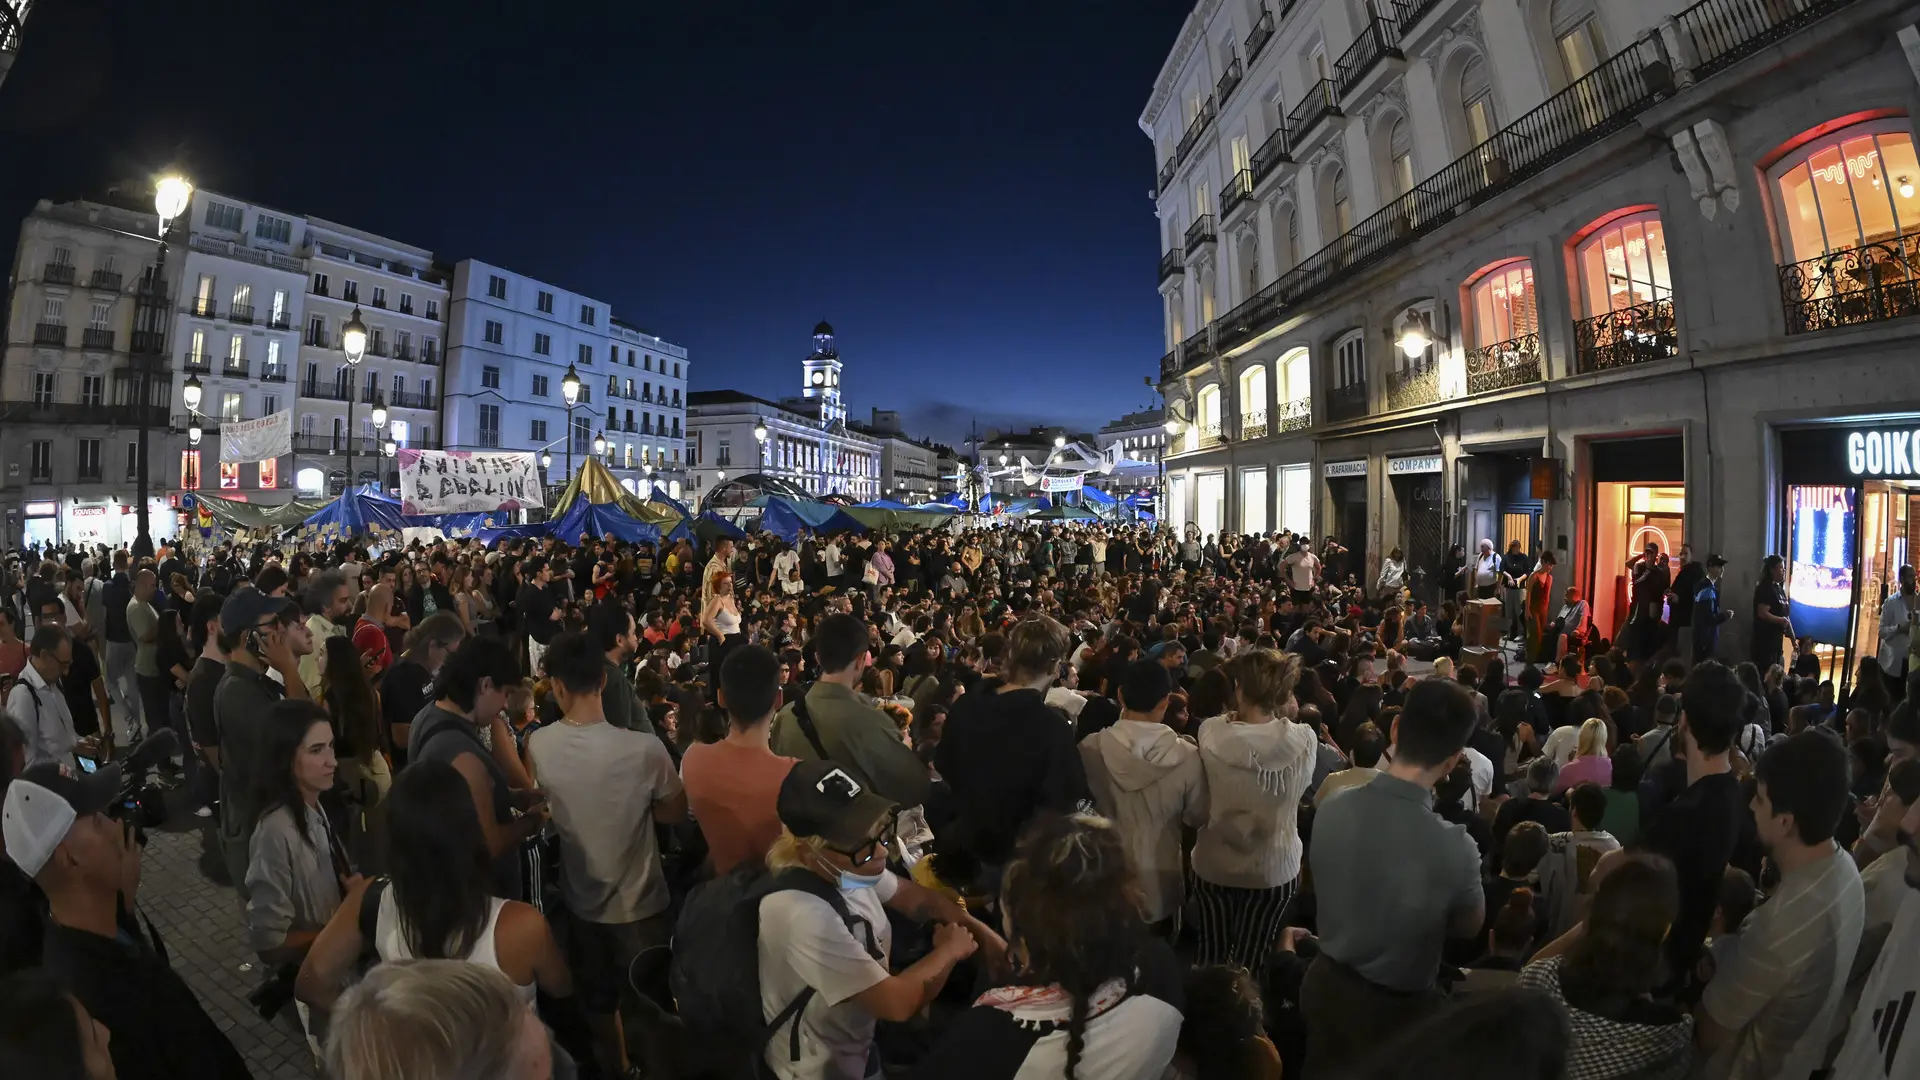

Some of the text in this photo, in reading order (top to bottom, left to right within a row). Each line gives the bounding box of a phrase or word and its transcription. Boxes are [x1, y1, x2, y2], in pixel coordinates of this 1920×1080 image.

[1326, 463, 1367, 474] PRAFARMACIA
[1393, 458, 1438, 471] COMPANY
[74, 508, 103, 516] SOUVENIRS
